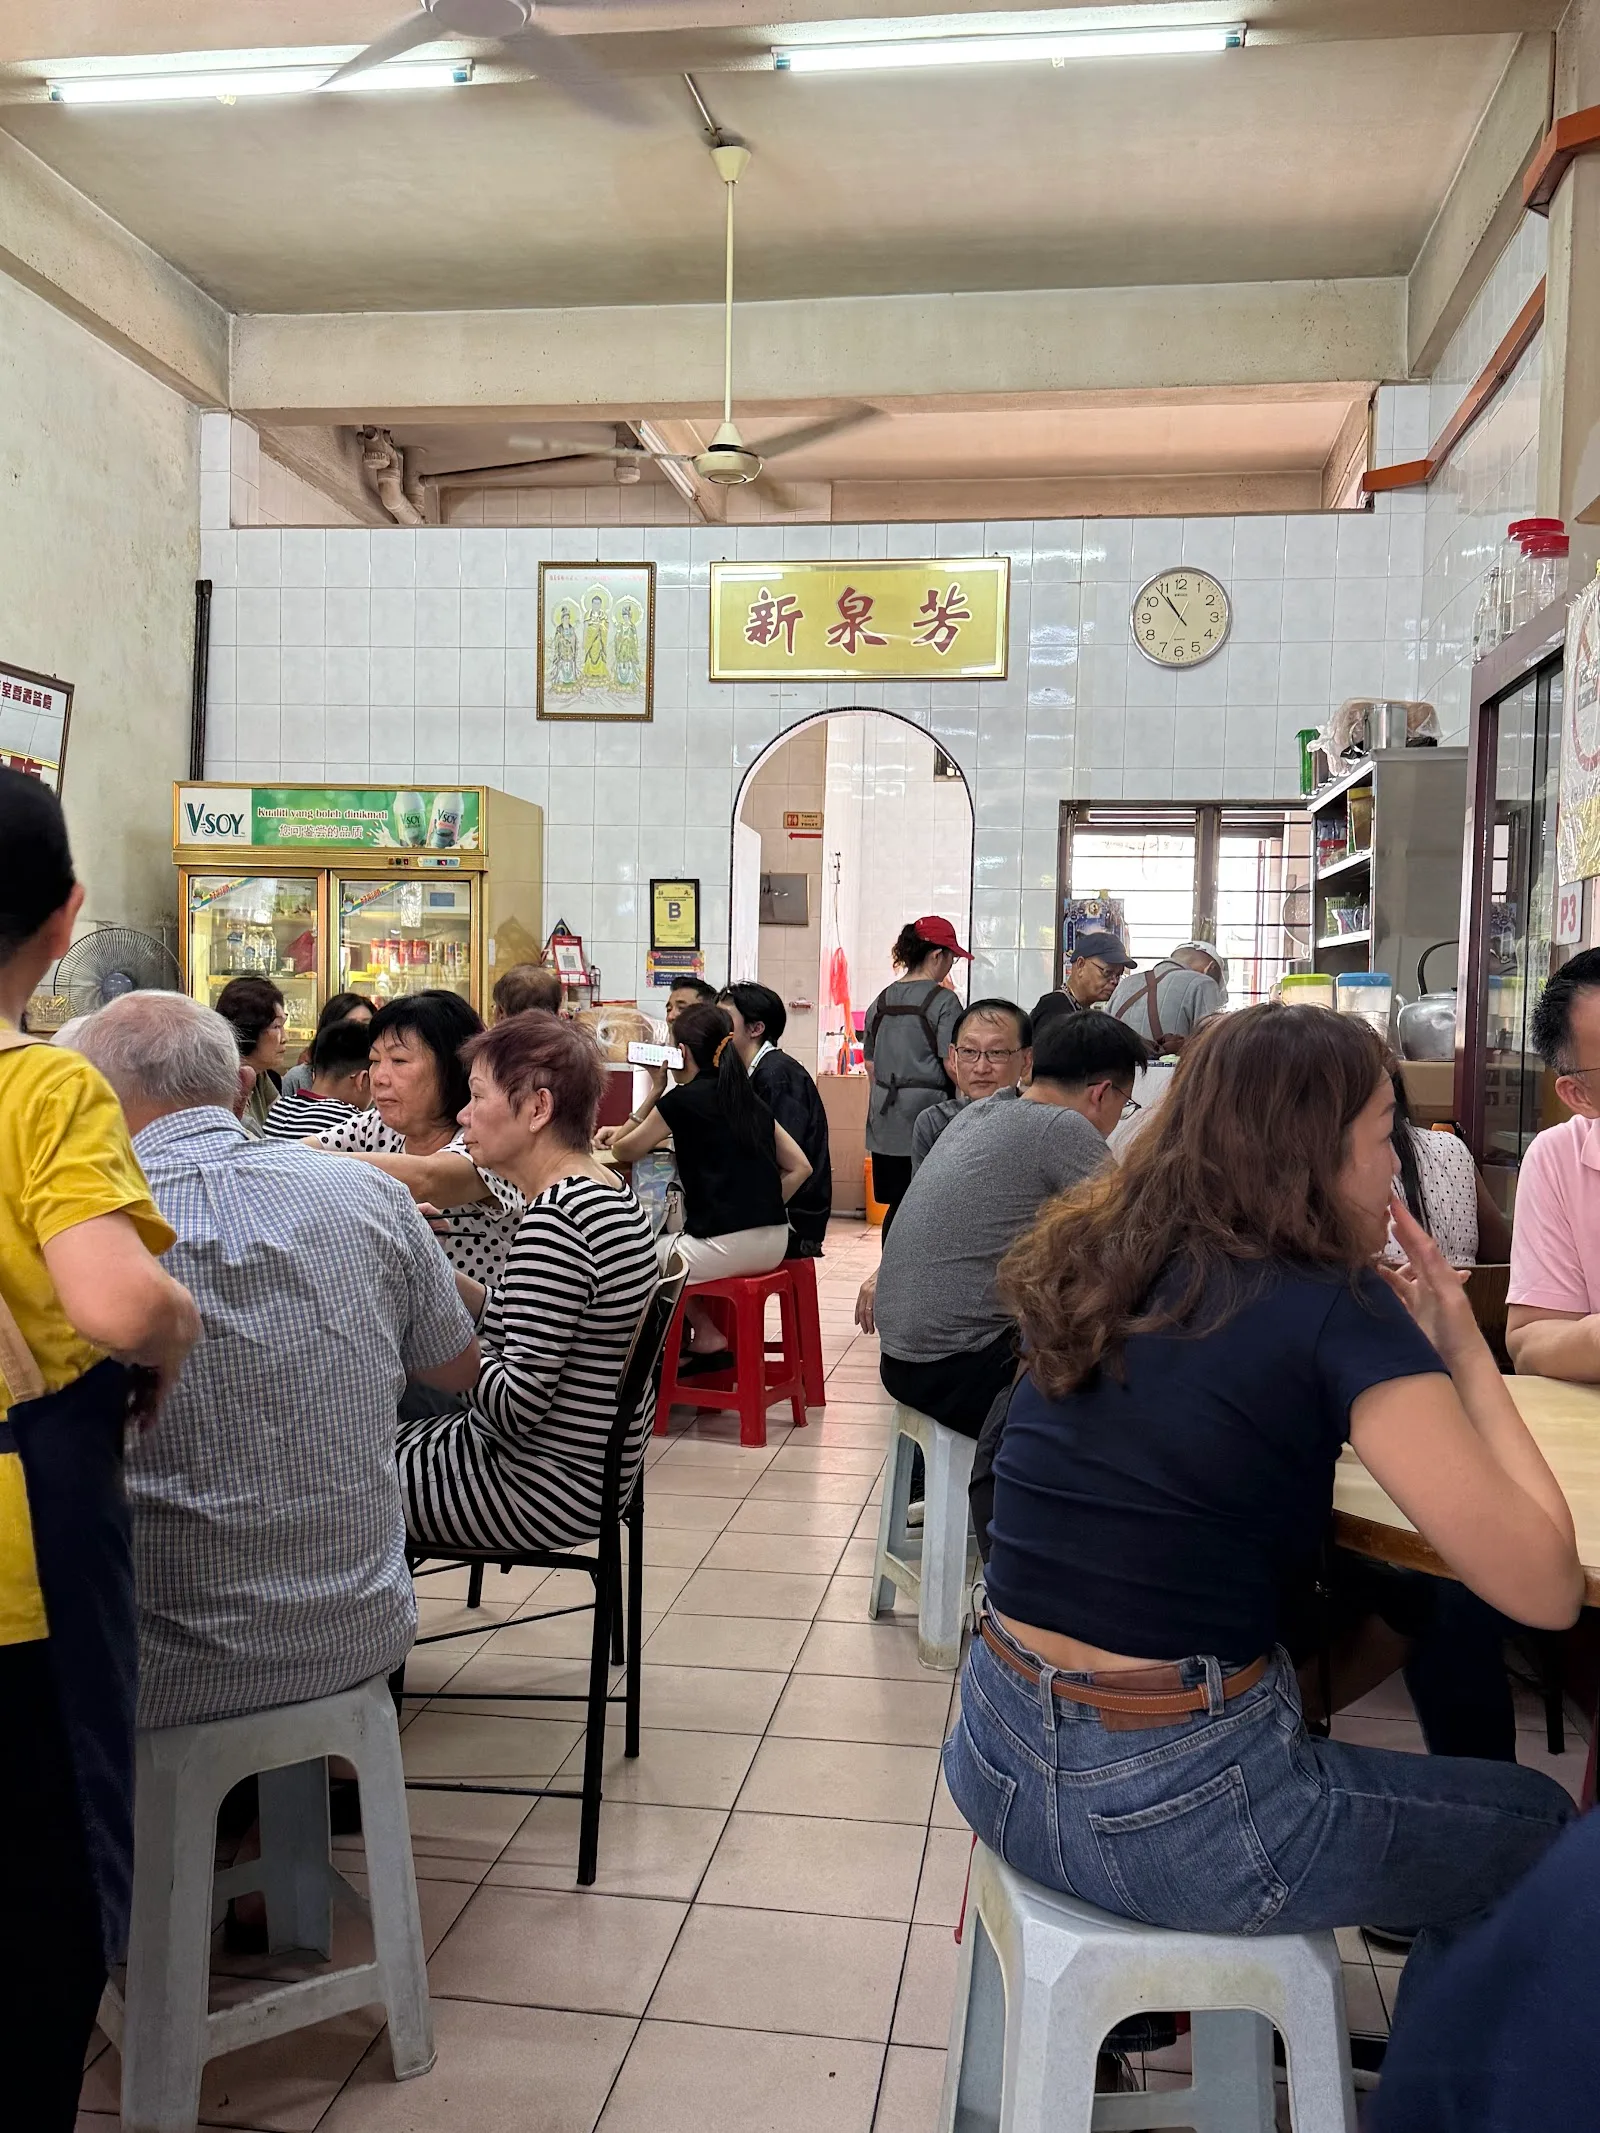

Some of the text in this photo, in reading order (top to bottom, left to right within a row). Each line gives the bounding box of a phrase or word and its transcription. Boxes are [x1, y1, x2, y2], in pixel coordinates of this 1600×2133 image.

[1160, 582, 1169, 594] 11
[1175, 578, 1187, 590] 12
[1197, 581, 1201, 594] 1
[1146, 596, 1159, 608] 10
[1205, 594, 1215, 606] 2
[745, 585, 971, 654] 新泉芳
[1141, 612, 1152, 624] 9
[1209, 611, 1220, 623] 3
[1145, 629, 1156, 641] 8
[1203, 628, 1213, 639] 4
[1159, 641, 1168, 653] 7
[1174, 645, 1184, 657] 6
[1191, 641, 1201, 653] 5
[185, 803, 245, 836] V-SOY
[258, 807, 388, 820] Kualiti yang boleh dinikmati
[668, 902, 682, 919] B
[1560, 893, 1577, 936] P3
